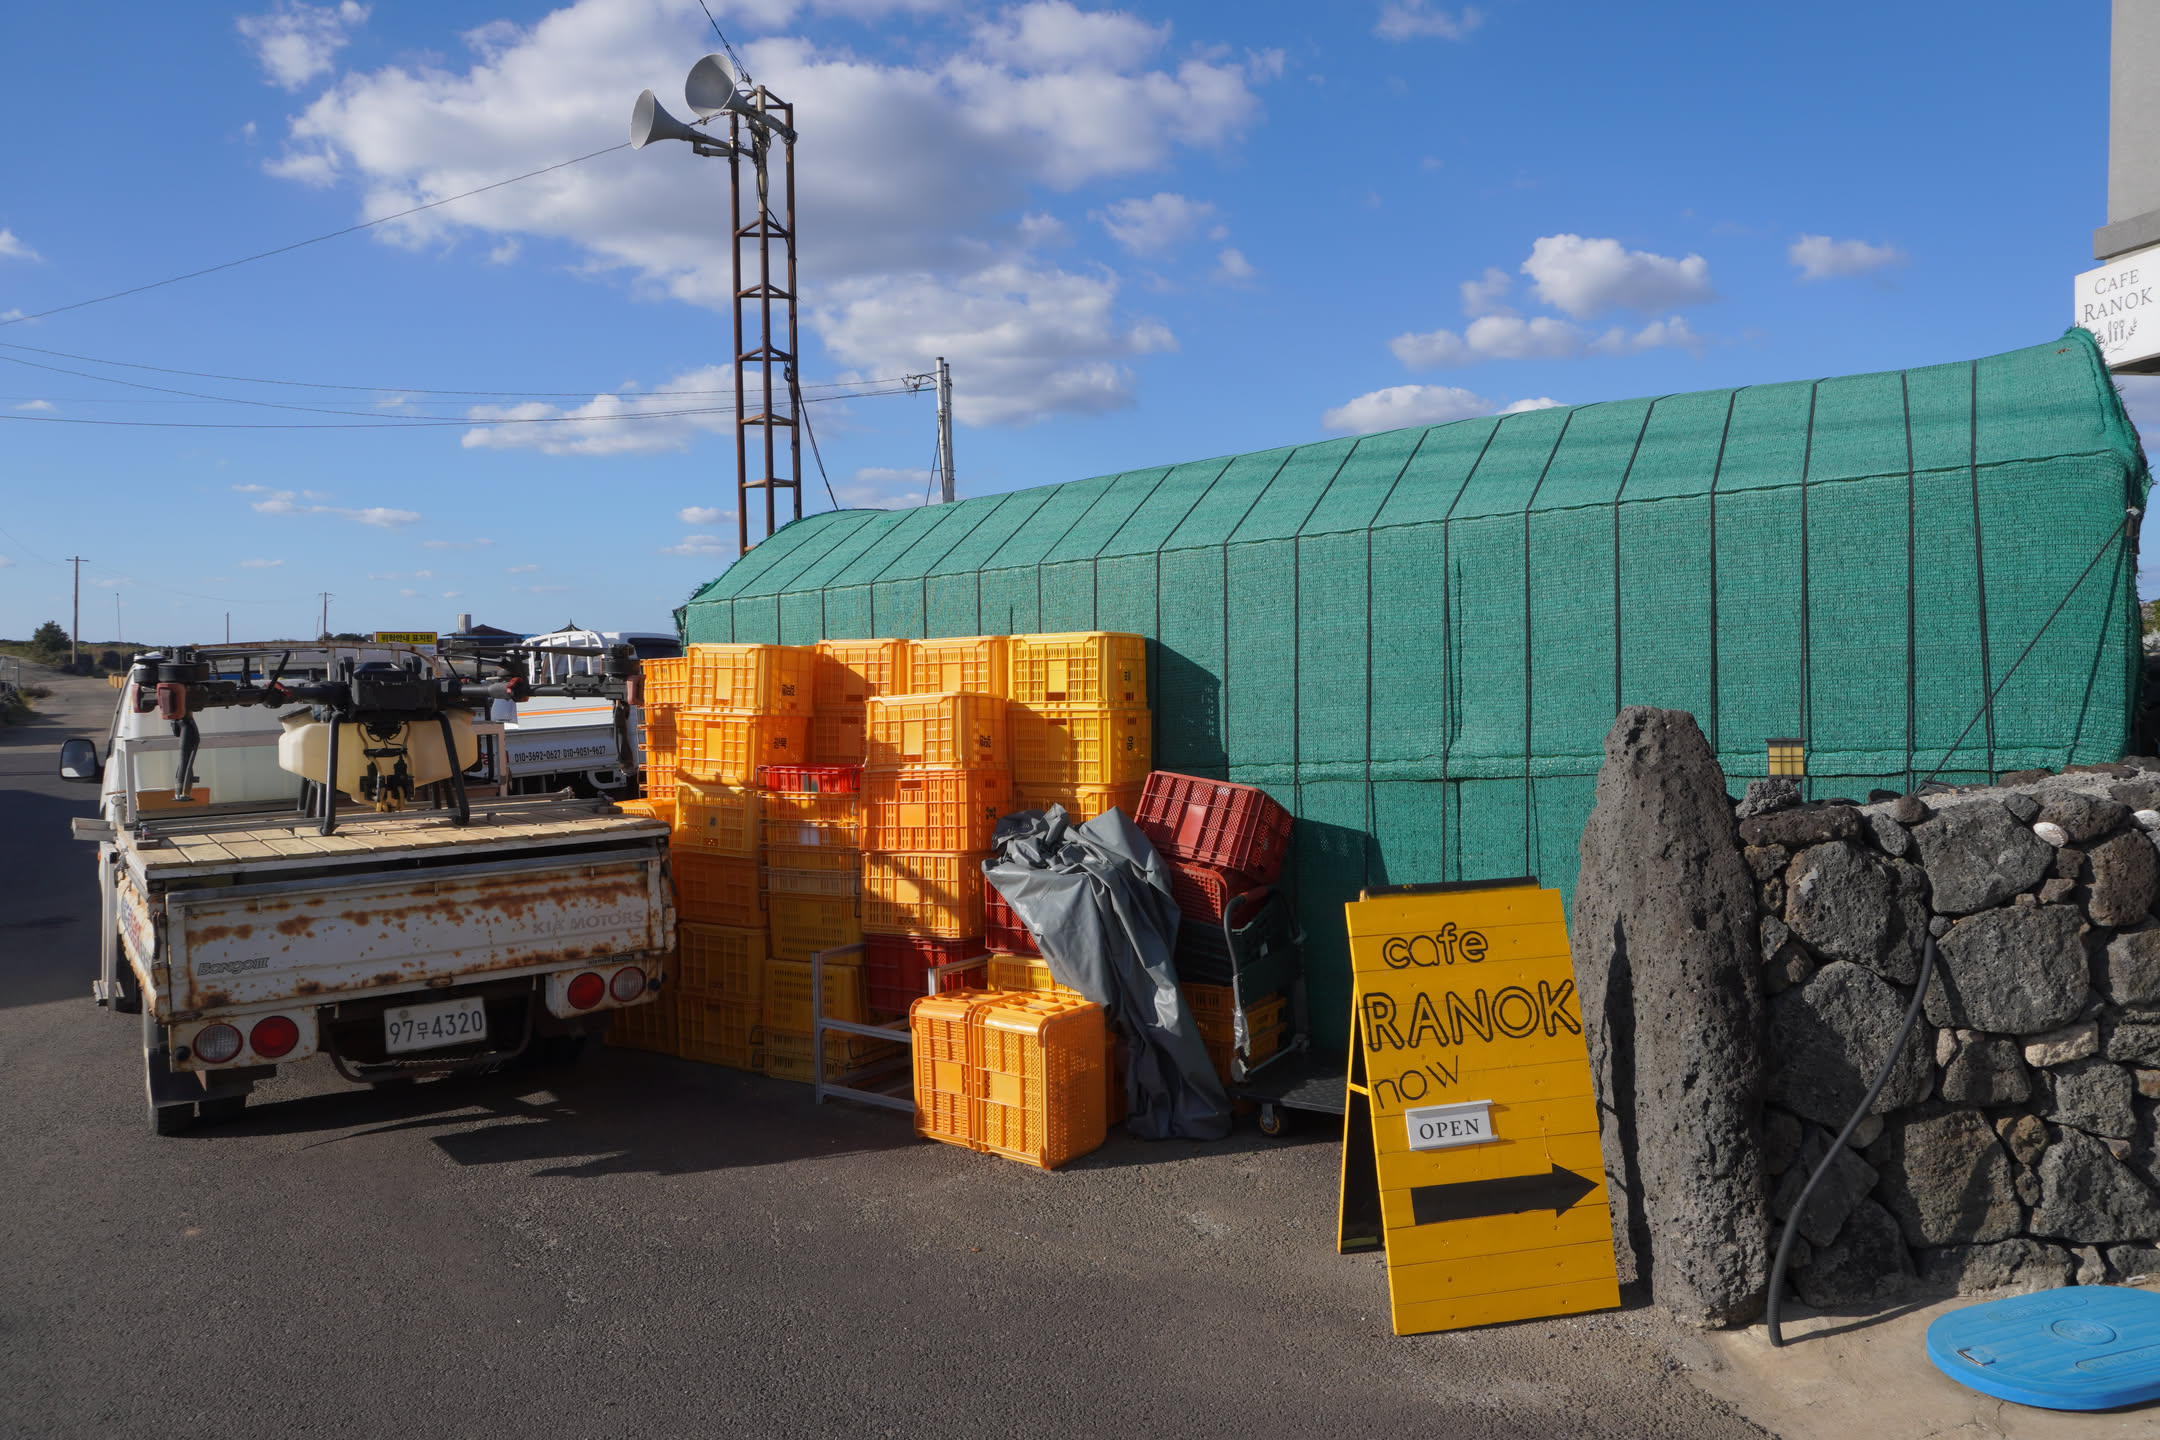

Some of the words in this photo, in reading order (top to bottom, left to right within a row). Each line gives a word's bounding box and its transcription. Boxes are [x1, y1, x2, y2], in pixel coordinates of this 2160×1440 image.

[2095, 269, 2139, 295] CAFE
[2084, 287, 2153, 323] RANOK
[532, 919, 565, 935] KIA
[569, 910, 645, 931] MOTORS
[1383, 922, 1489, 969] cafe
[389, 1010, 483, 1045] 97무4320
[1363, 979, 1582, 1052] RANOK
[1373, 1055, 1460, 1109] now
[1419, 1118, 1481, 1140] OPEN
